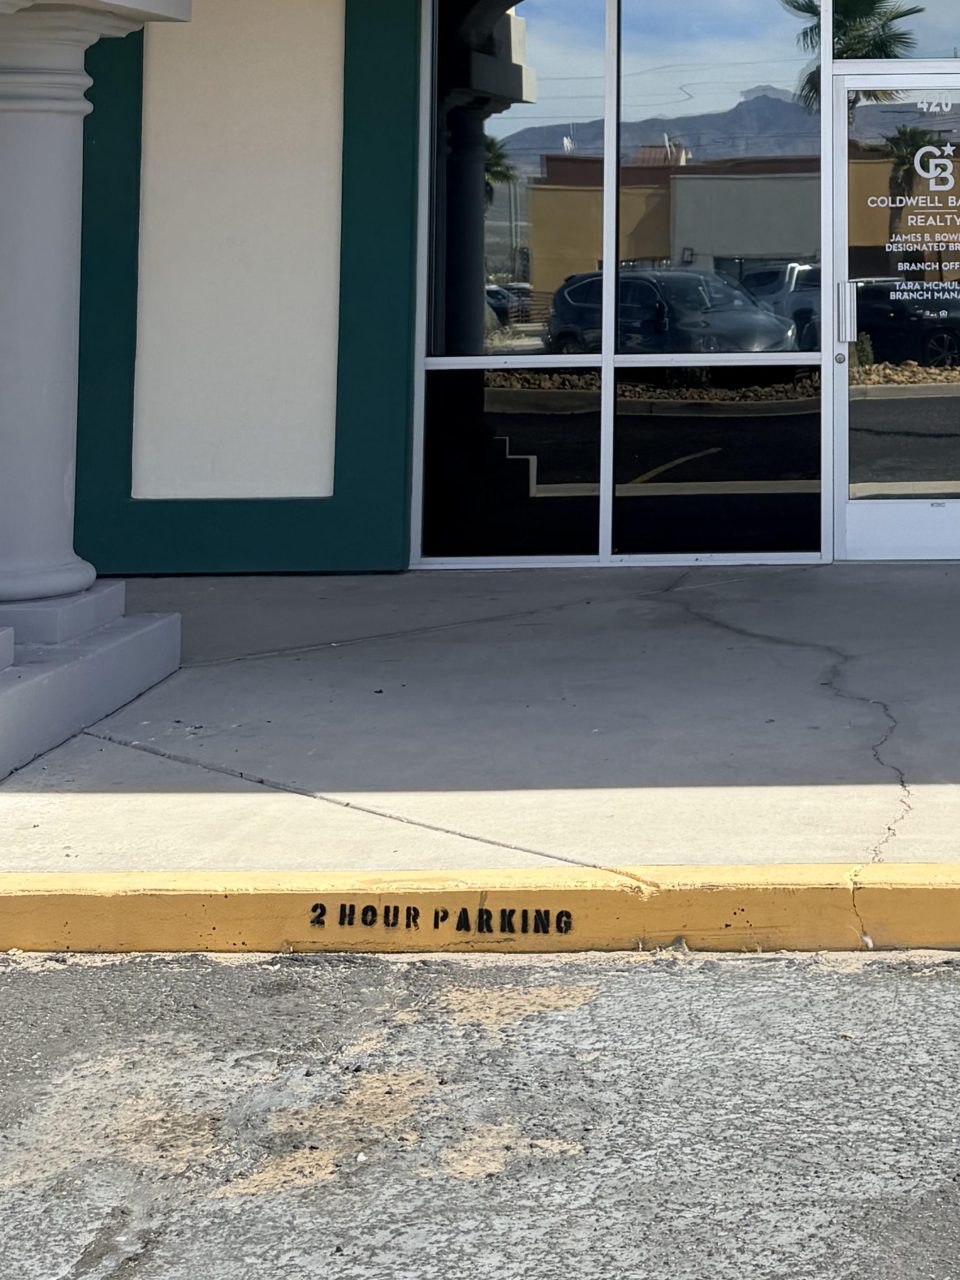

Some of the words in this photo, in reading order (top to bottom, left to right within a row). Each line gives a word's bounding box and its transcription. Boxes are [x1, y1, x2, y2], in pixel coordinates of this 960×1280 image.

[917, 93, 952, 112] 420
[867, 195, 943, 207] COLDWELL
[889, 233, 922, 242] JAMES
[924, 233, 933, 241] B.
[885, 243, 946, 252] DESIGNATED
[897, 262, 939, 271] BRANCH
[895, 281, 921, 290] TARA
[889, 291, 932, 300] BRANCH
[310, 902, 327, 928] 2
[338, 903, 420, 930] HOUR
[432, 907, 573, 935] PARKING
